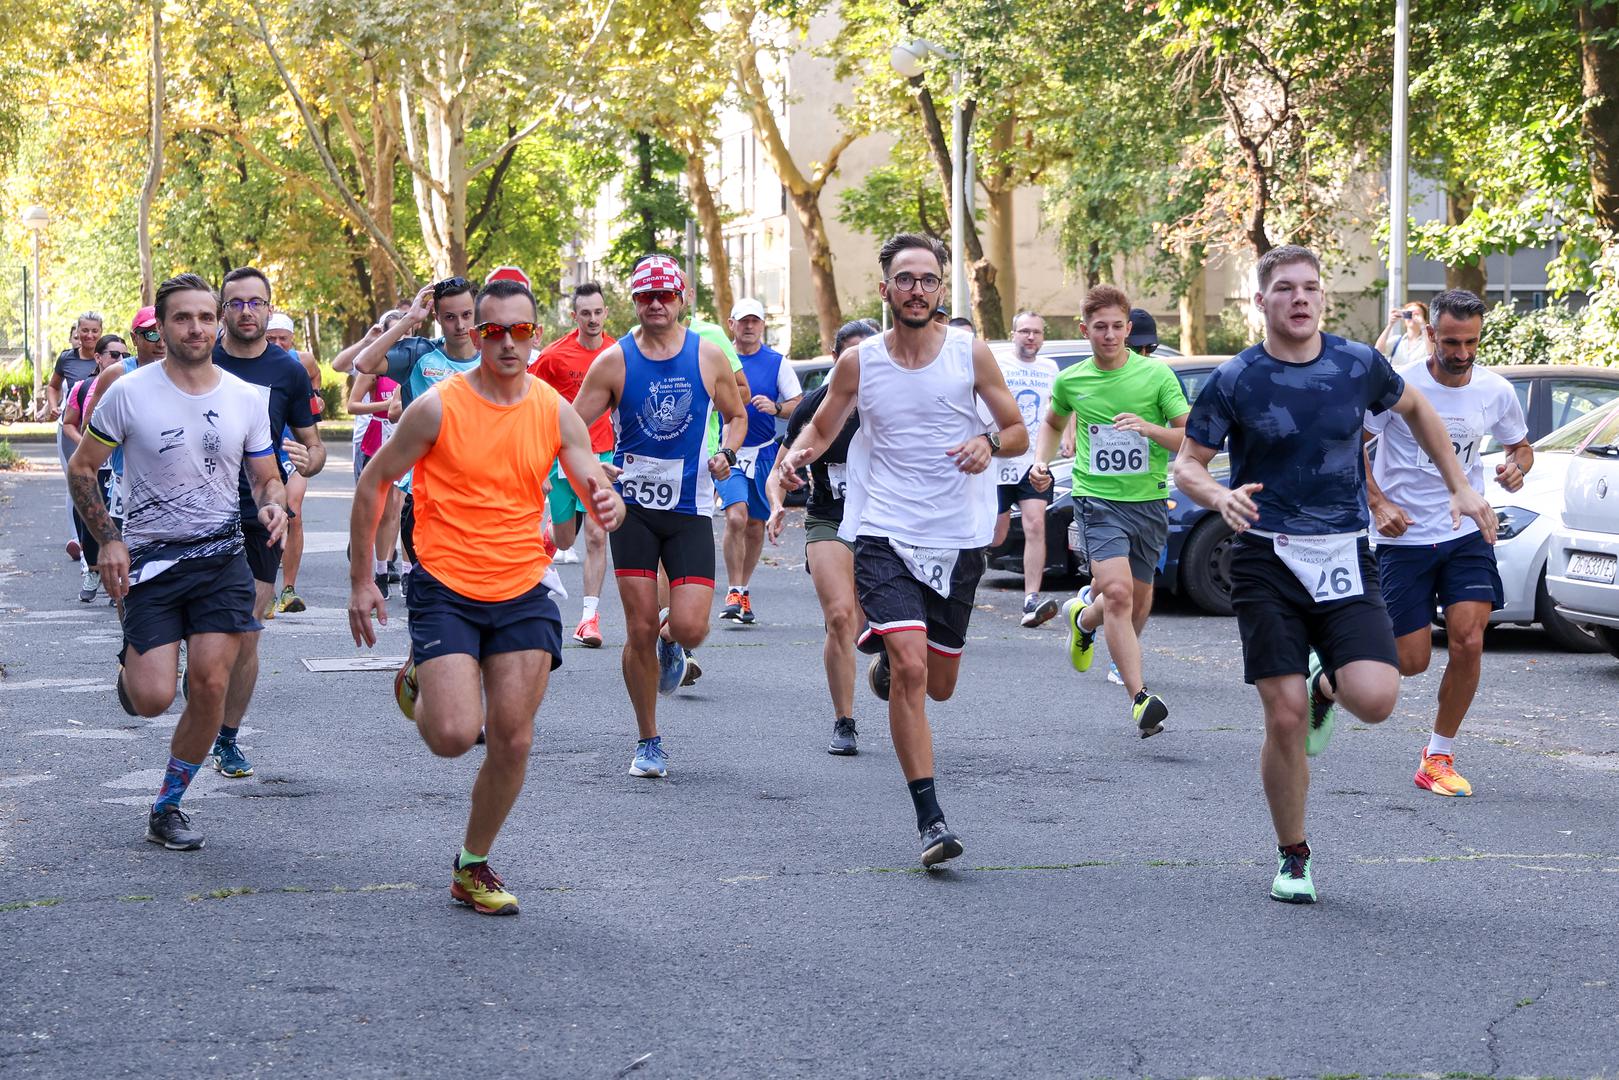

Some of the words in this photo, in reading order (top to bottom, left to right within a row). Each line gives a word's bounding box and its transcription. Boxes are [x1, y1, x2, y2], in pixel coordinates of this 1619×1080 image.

[642, 275, 670, 283] CROATIA
[1007, 379, 1027, 388] Walk
[1096, 448, 1143, 472] 696
[622, 479, 673, 507] 659
[1314, 566, 1353, 598] 26
